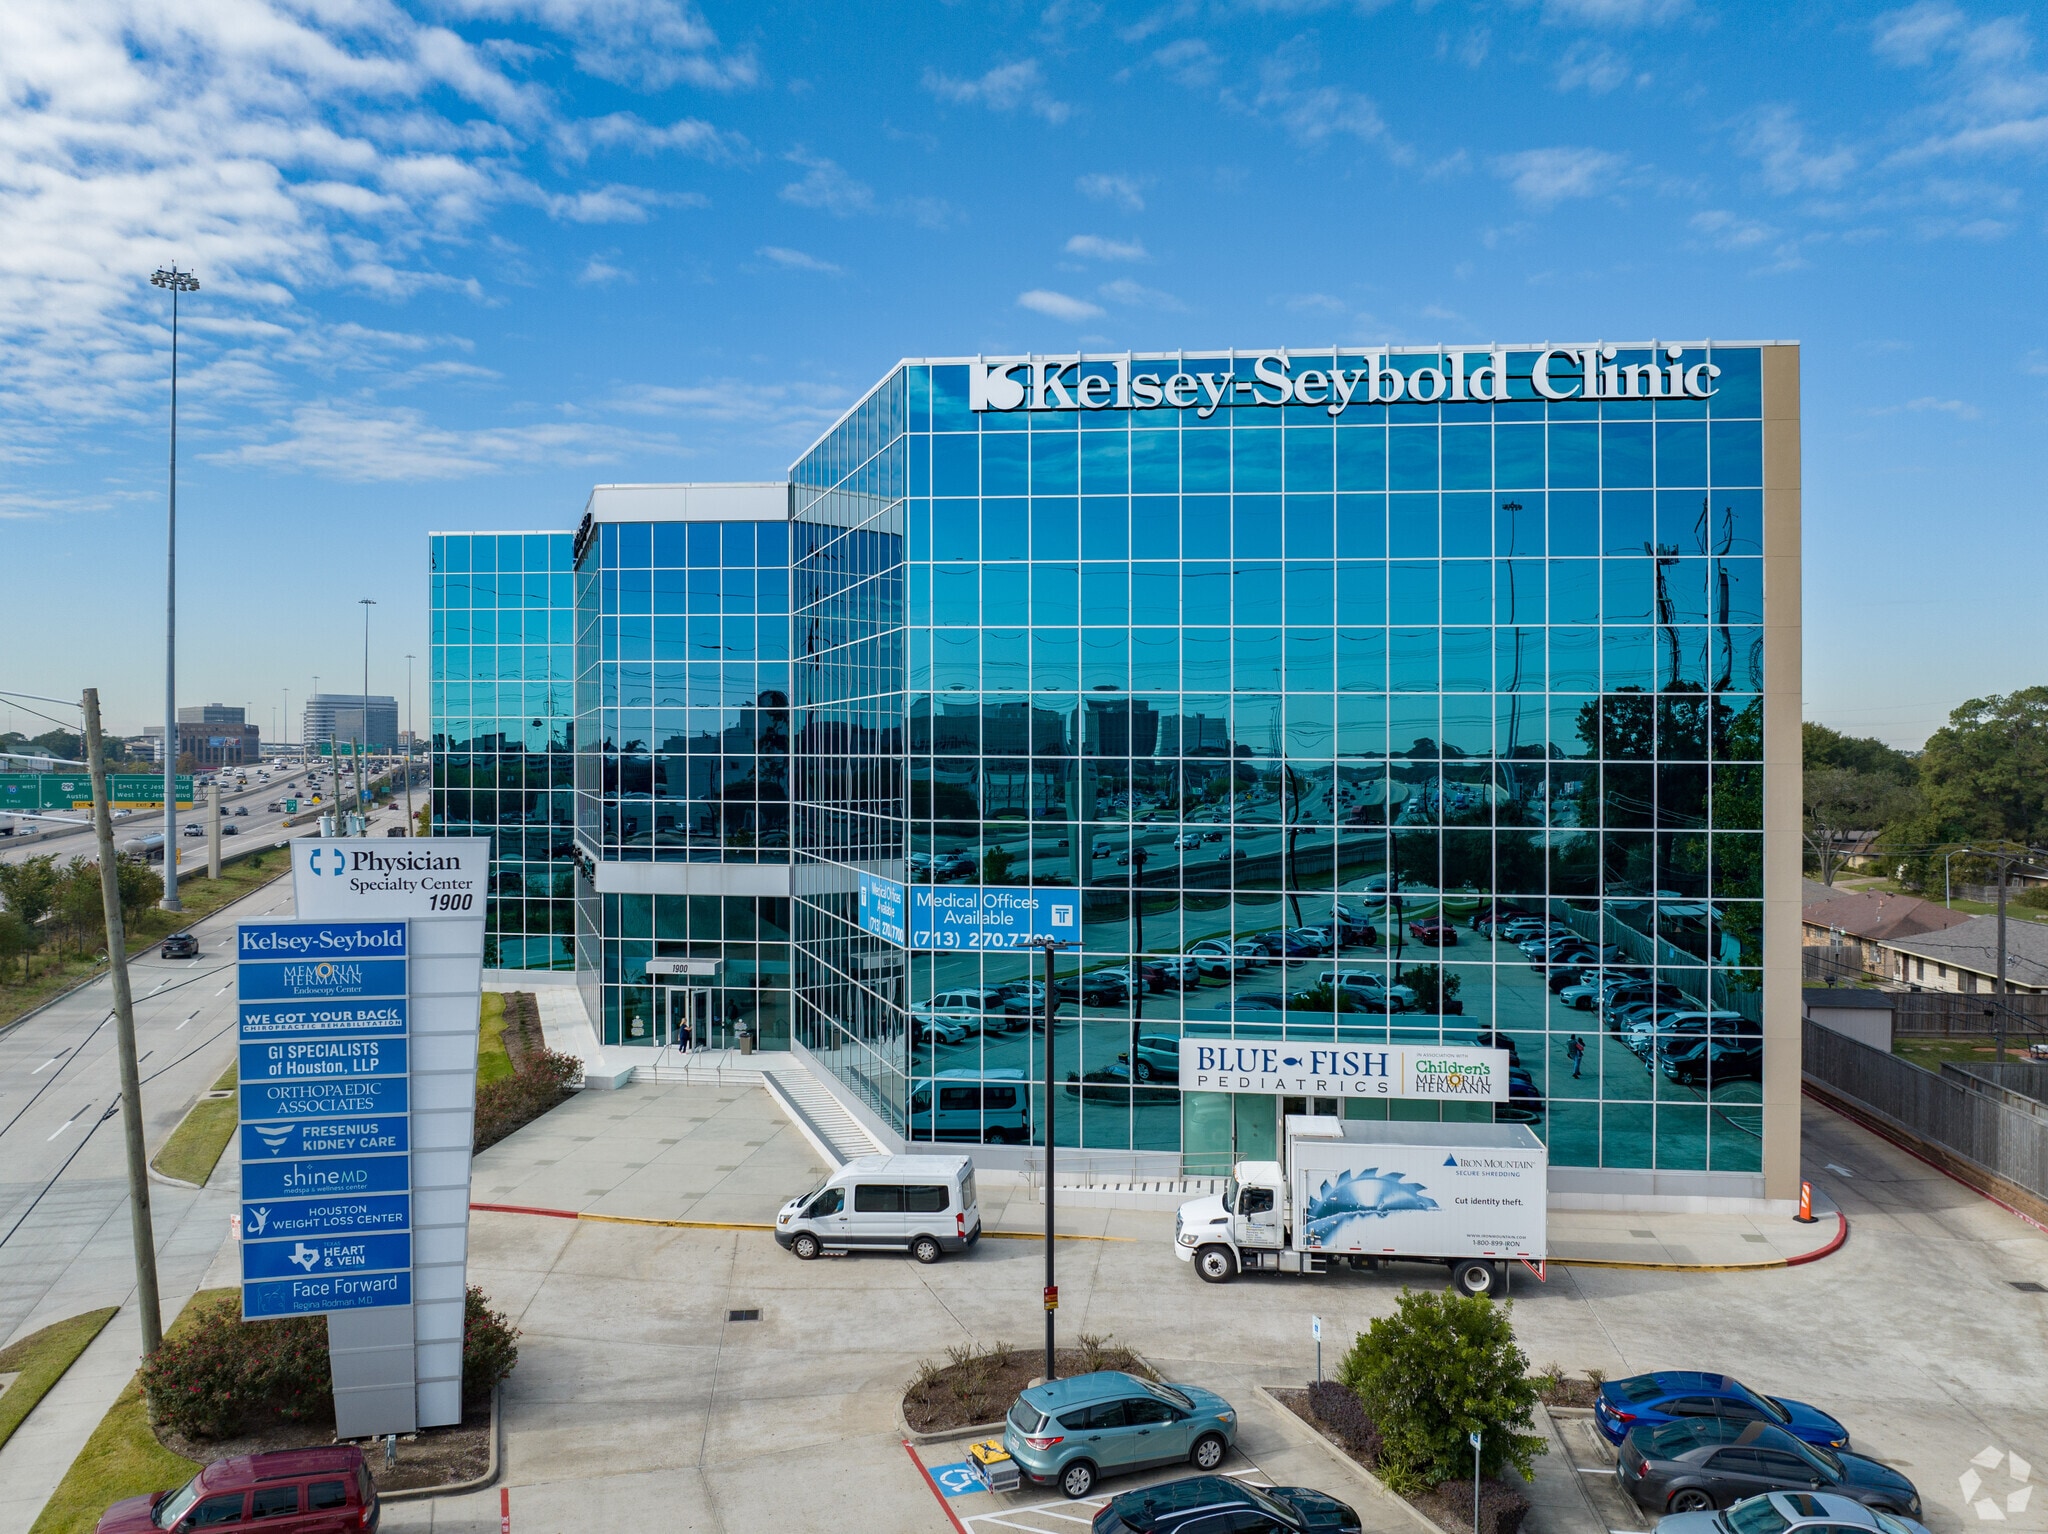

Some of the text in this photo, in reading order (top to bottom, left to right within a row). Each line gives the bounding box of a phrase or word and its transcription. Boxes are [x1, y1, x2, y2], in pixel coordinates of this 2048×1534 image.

[1027, 352, 1512, 417] Kelsey-Seybold
[1532, 345, 1721, 399] Clinic
[350, 851, 461, 877] Physician
[350, 877, 473, 894] Specialty Center
[429, 894, 473, 911] 1900
[917, 892, 1040, 909] Medical Offices
[944, 910, 1014, 925] Available
[241, 929, 403, 953] Kelsey-Seybold
[913, 931, 961, 948] (713)
[284, 963, 362, 978] MEMORIAL
[672, 964, 688, 973] 1900
[284, 973, 362, 986] HERMANN
[293, 985, 362, 995] Endoscopy Center
[245, 1007, 398, 1024] WE GOT YOUR BACK
[243, 1020, 401, 1032] CHIROPRACTIC REHABILITATION
[268, 1042, 379, 1060] GI SPECIALISTS
[268, 1058, 379, 1075] of Houston, LLP
[1197, 1046, 1389, 1077] BLUE FISH
[1416, 1060, 1491, 1075] Children's
[1197, 1075, 1389, 1093] PEDIATRICS
[1416, 1073, 1492, 1086] MEMORIAL
[267, 1082, 382, 1099] ORTHOPAEDIC
[1416, 1082, 1492, 1094] HERMANN
[277, 1097, 374, 1114] ASSOCIATES
[302, 1123, 379, 1137] FRESENIUS
[303, 1136, 396, 1151] KIDNEY CARE
[1455, 1197, 1524, 1207] Cut identity theft.
[309, 1205, 367, 1216] HOUSTON
[272, 1213, 403, 1229] WEIGHT LOSS CENTER
[1473, 1239, 1520, 1247] 1-800-899-IRON
[324, 1245, 365, 1257] HEART
[324, 1257, 334, 1267] &
[337, 1255, 365, 1266] VEIN
[293, 1275, 398, 1297] Face Forward
[293, 1301, 320, 1311] Regina
